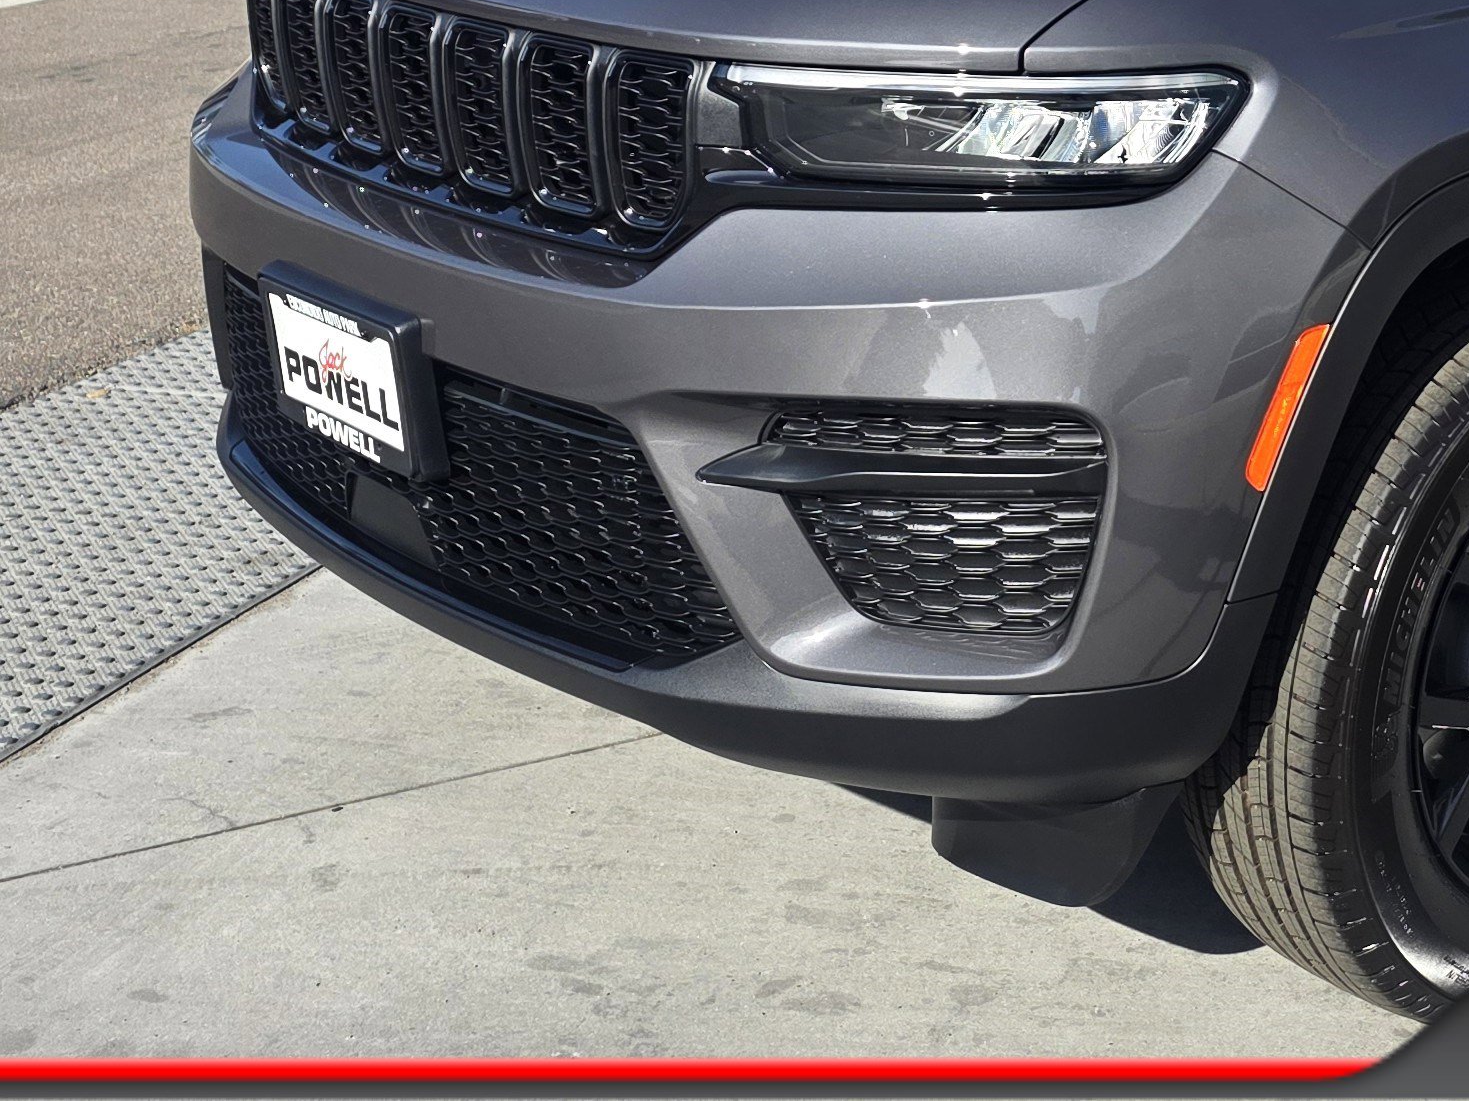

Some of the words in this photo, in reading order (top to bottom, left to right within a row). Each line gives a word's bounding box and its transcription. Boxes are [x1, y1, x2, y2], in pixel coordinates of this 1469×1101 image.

[284, 346, 400, 432] POWELL
[318, 338, 353, 383] Jack
[304, 405, 382, 464] POWELL
[1382, 507, 1456, 707] MICHELIN
